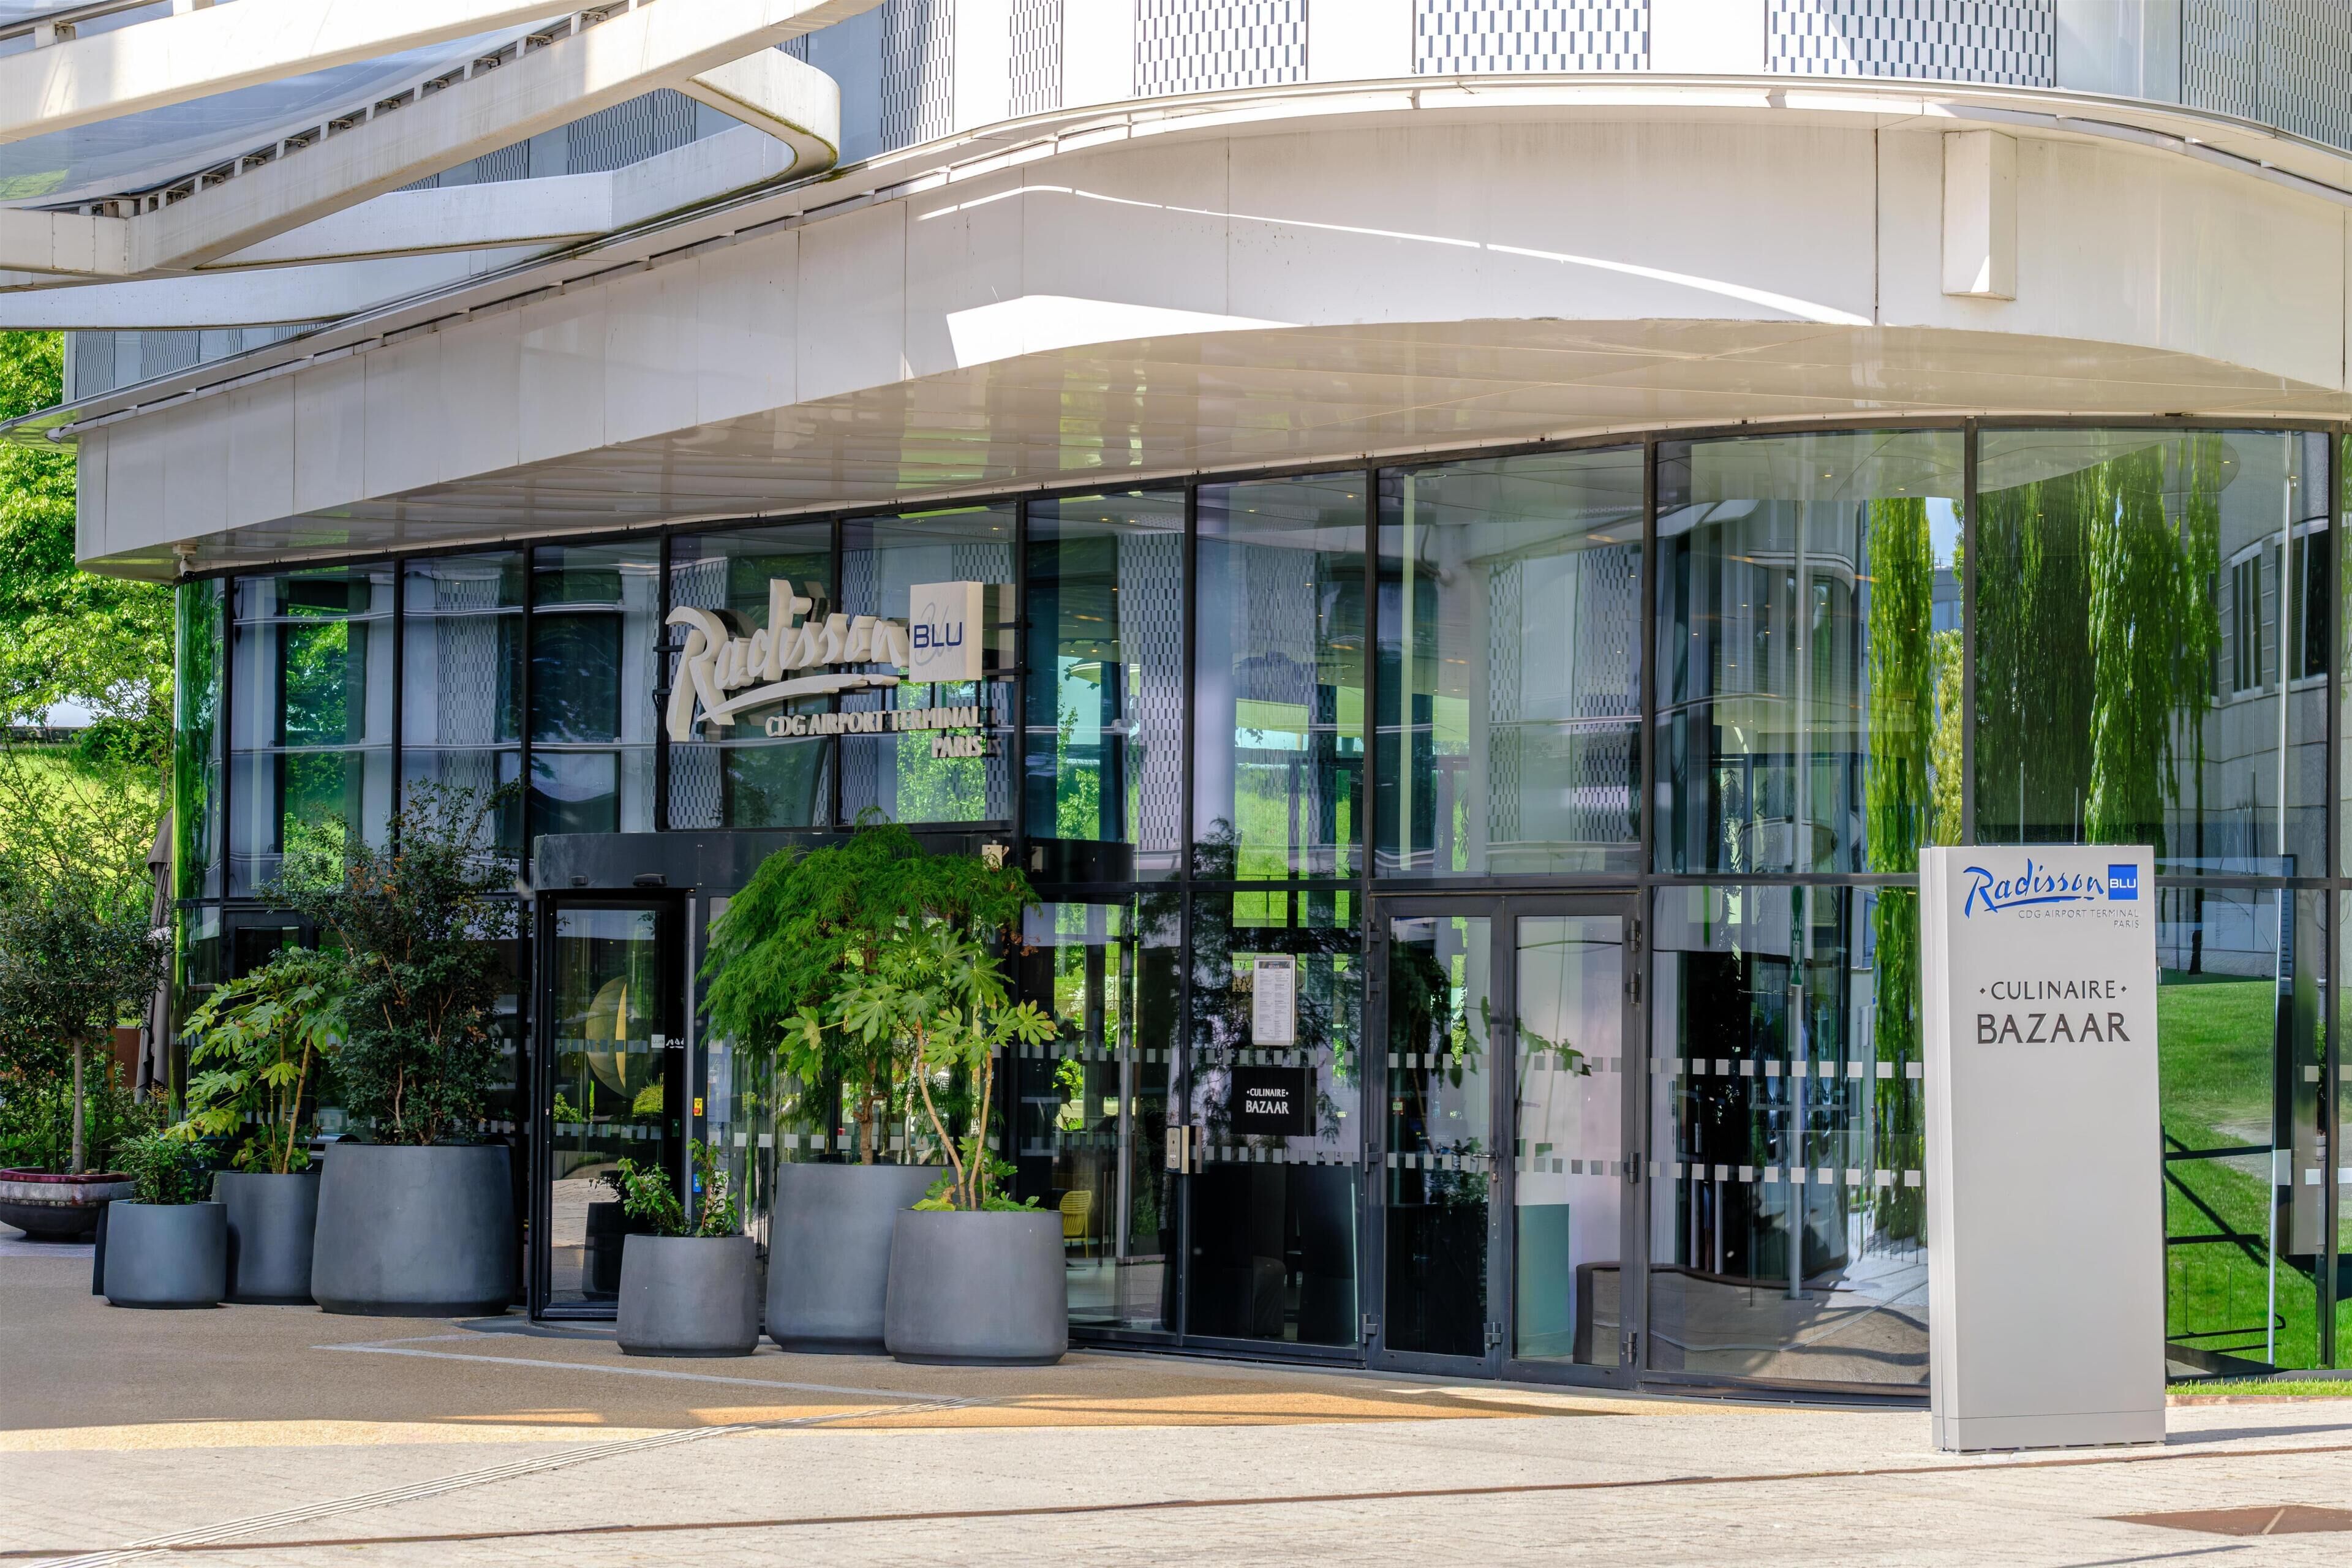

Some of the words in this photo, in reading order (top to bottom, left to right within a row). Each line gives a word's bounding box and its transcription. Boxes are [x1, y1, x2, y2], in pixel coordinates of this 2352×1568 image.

[666, 578, 910, 742] Radisson
[914, 622, 962, 649] BLU
[766, 715, 806, 737] CDG
[808, 710, 886, 735] AIRPORT
[888, 706, 983, 732] TERMINAL
[932, 735, 982, 758] PARIS
[1963, 858, 2105, 919] Radisson
[2109, 878, 2136, 888] BLU
[2045, 910, 2087, 918] AIRPORT
[2090, 909, 2139, 918] TERMINAL
[2114, 920, 2139, 929] PARIS
[1991, 981, 2116, 1000] CULINAIRE
[1977, 1012, 2130, 1044] BAZAAR
[1250, 1088, 1286, 1097] CULINAIRE
[1246, 1100, 1289, 1114] BAZAAR
